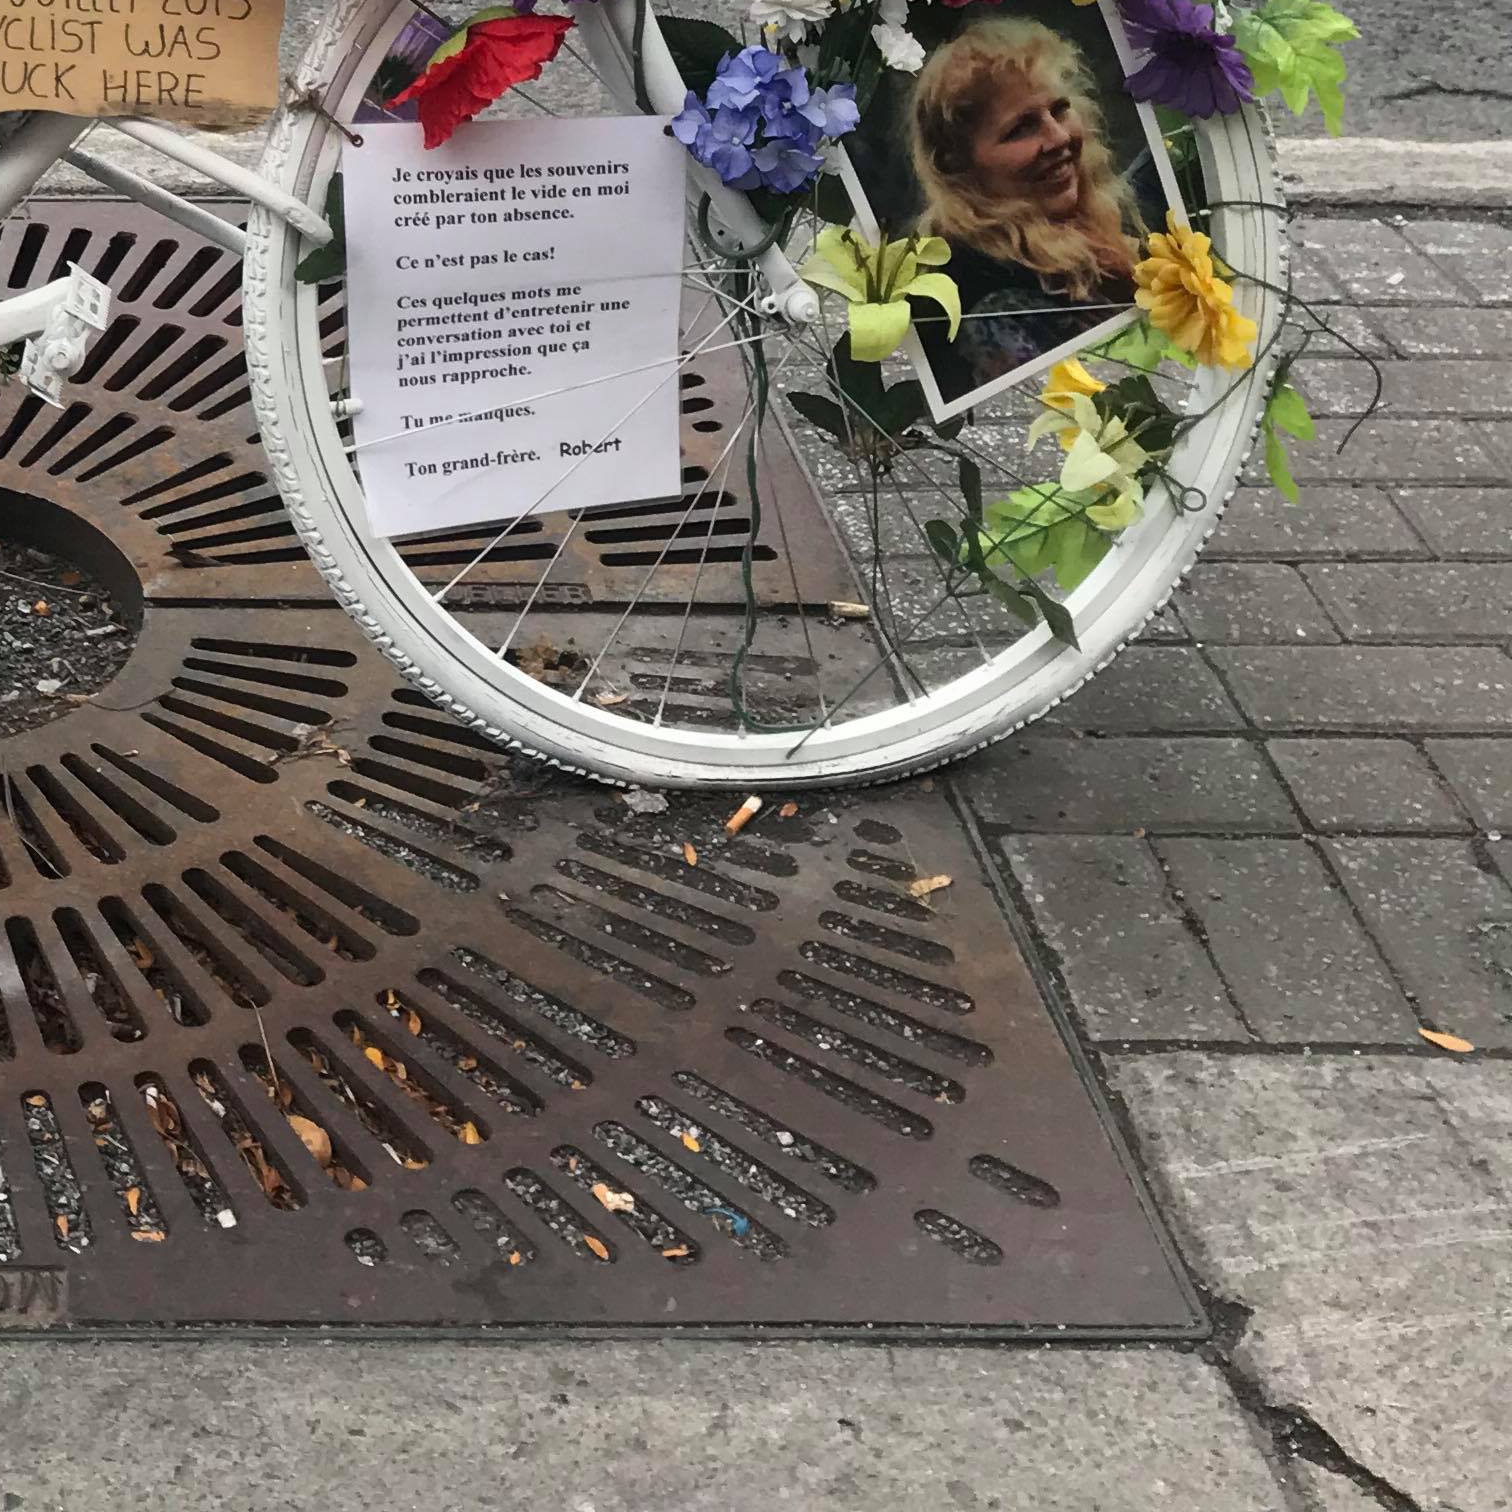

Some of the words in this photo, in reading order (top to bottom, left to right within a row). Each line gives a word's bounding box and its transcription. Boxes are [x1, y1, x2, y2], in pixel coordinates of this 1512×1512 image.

[124, 22, 222, 61] WAS
[102, 68, 207, 110] HERE
[391, 167, 412, 183] Je
[416, 165, 479, 185] croyais
[483, 166, 515, 184] que
[519, 163, 543, 179] les
[547, 159, 630, 177] souvenirs
[393, 187, 507, 205] combleraient
[510, 185, 527, 201] le
[530, 183, 568, 200] vide
[571, 185, 592, 198] en
[597, 180, 630, 196] moi
[394, 211, 431, 228] créé
[435, 213, 466, 229] par
[470, 211, 498, 225] ton
[502, 207, 575, 224] absence.
[395, 255, 420, 270] Ce
[424, 253, 465, 269] n’est
[470, 253, 499, 269] pas
[503, 249, 518, 264] le
[522, 246, 556, 262] cas!
[396, 295, 428, 310] Ces
[432, 291, 507, 310] quelques
[511, 286, 552, 301] mots
[556, 285, 582, 297] me
[397, 310, 490, 332] permettent
[494, 300, 596, 320] d’entretenir
[600, 299, 631, 312] une
[397, 328, 503, 348] conversation
[507, 325, 546, 338] avec
[549, 319, 572, 334] toi
[575, 319, 592, 332] et
[396, 351, 426, 371] j’ai
[430, 343, 533, 365] l’impression
[537, 342, 568, 358] que
[571, 339, 591, 354] ça
[399, 373, 437, 388] nous
[442, 363, 533, 385] rapproche.
[399, 414, 425, 430] Tu
[429, 412, 454, 426] me
[404, 461, 438, 479] Ton
[441, 449, 541, 476] grand-frère.
[559, 437, 623, 458] Robert
